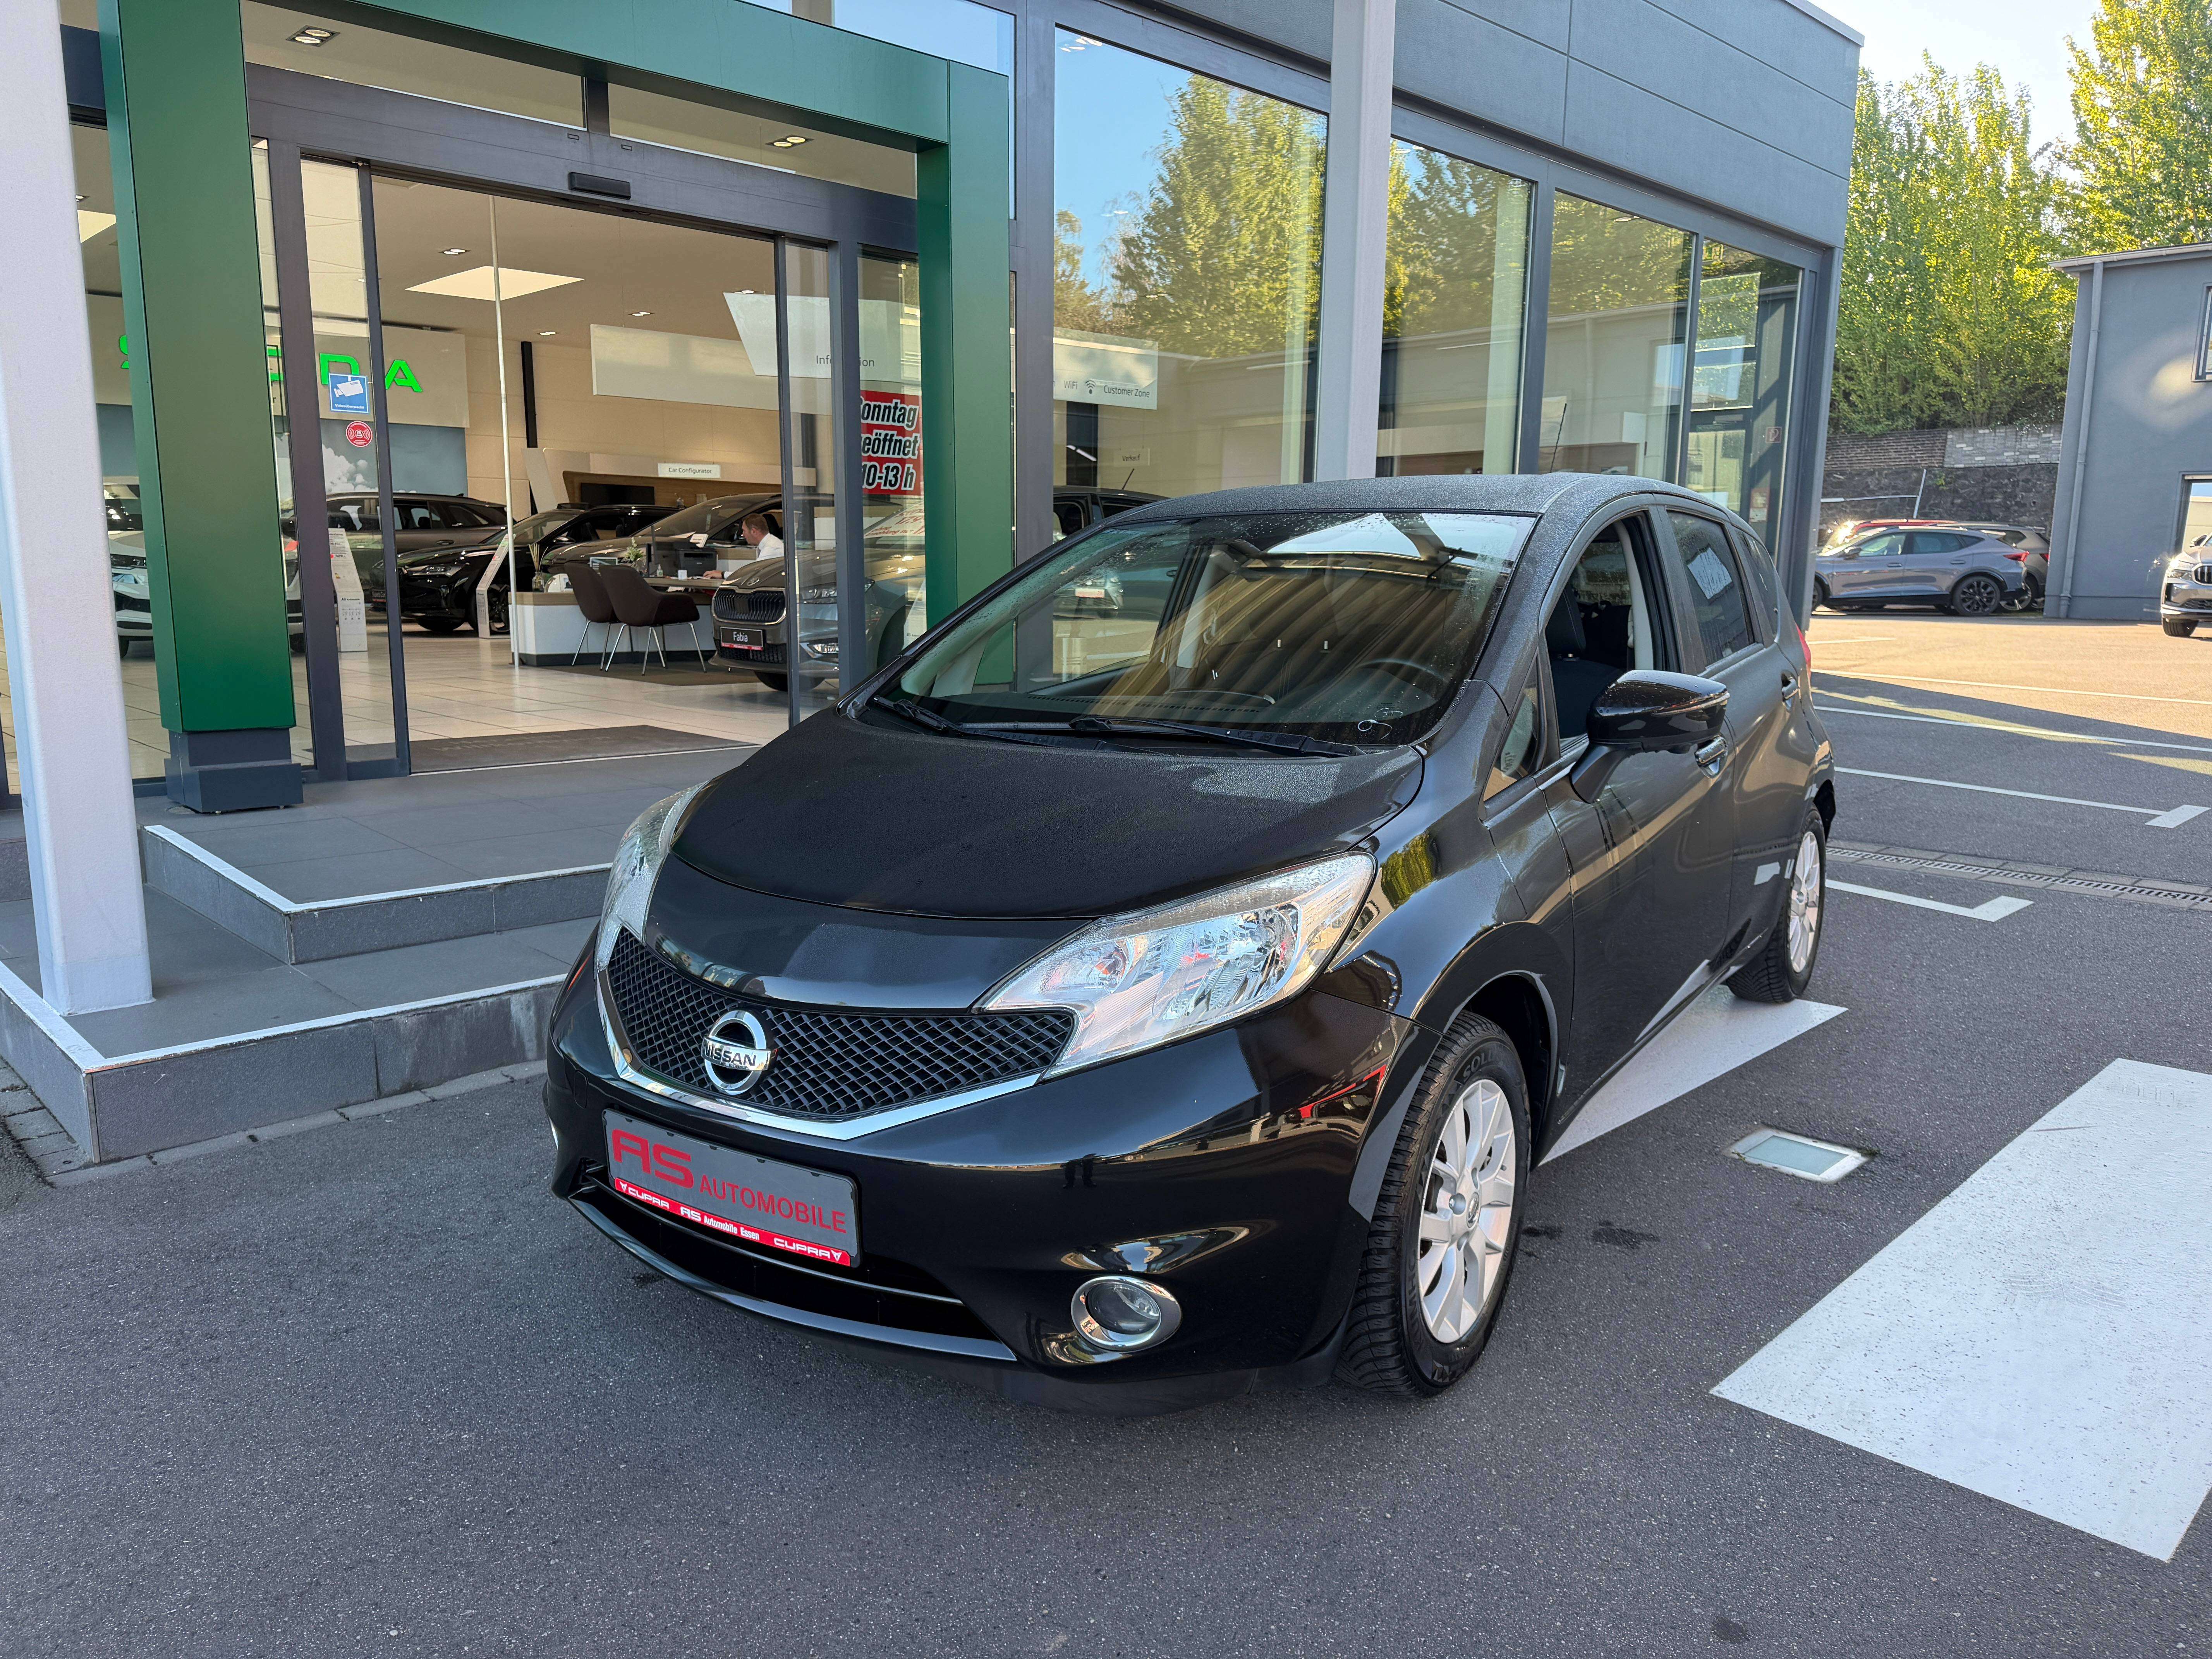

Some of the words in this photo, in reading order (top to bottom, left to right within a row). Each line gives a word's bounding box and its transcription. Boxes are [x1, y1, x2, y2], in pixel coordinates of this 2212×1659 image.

[816, 355, 875, 367] Infion
[1064, 380, 1078, 390] WiFi
[1104, 385, 1133, 396] Customer
[1135, 388, 1150, 398] Zone
[860, 397, 918, 428] onntag
[862, 431, 919, 457] eöffnet
[903, 466, 914, 488] h
[733, 631, 748, 642] Fabia
[704, 1039, 757, 1066] NISSAN
[611, 1128, 694, 1188] AS
[700, 1175, 847, 1233] AUTOMOBILE
[628, 1187, 670, 1210] CUPRA
[680, 1206, 702, 1222] AS
[704, 1215, 738, 1235] Automobile
[740, 1226, 760, 1241] Essen
[774, 1238, 831, 1260] CUPRA
